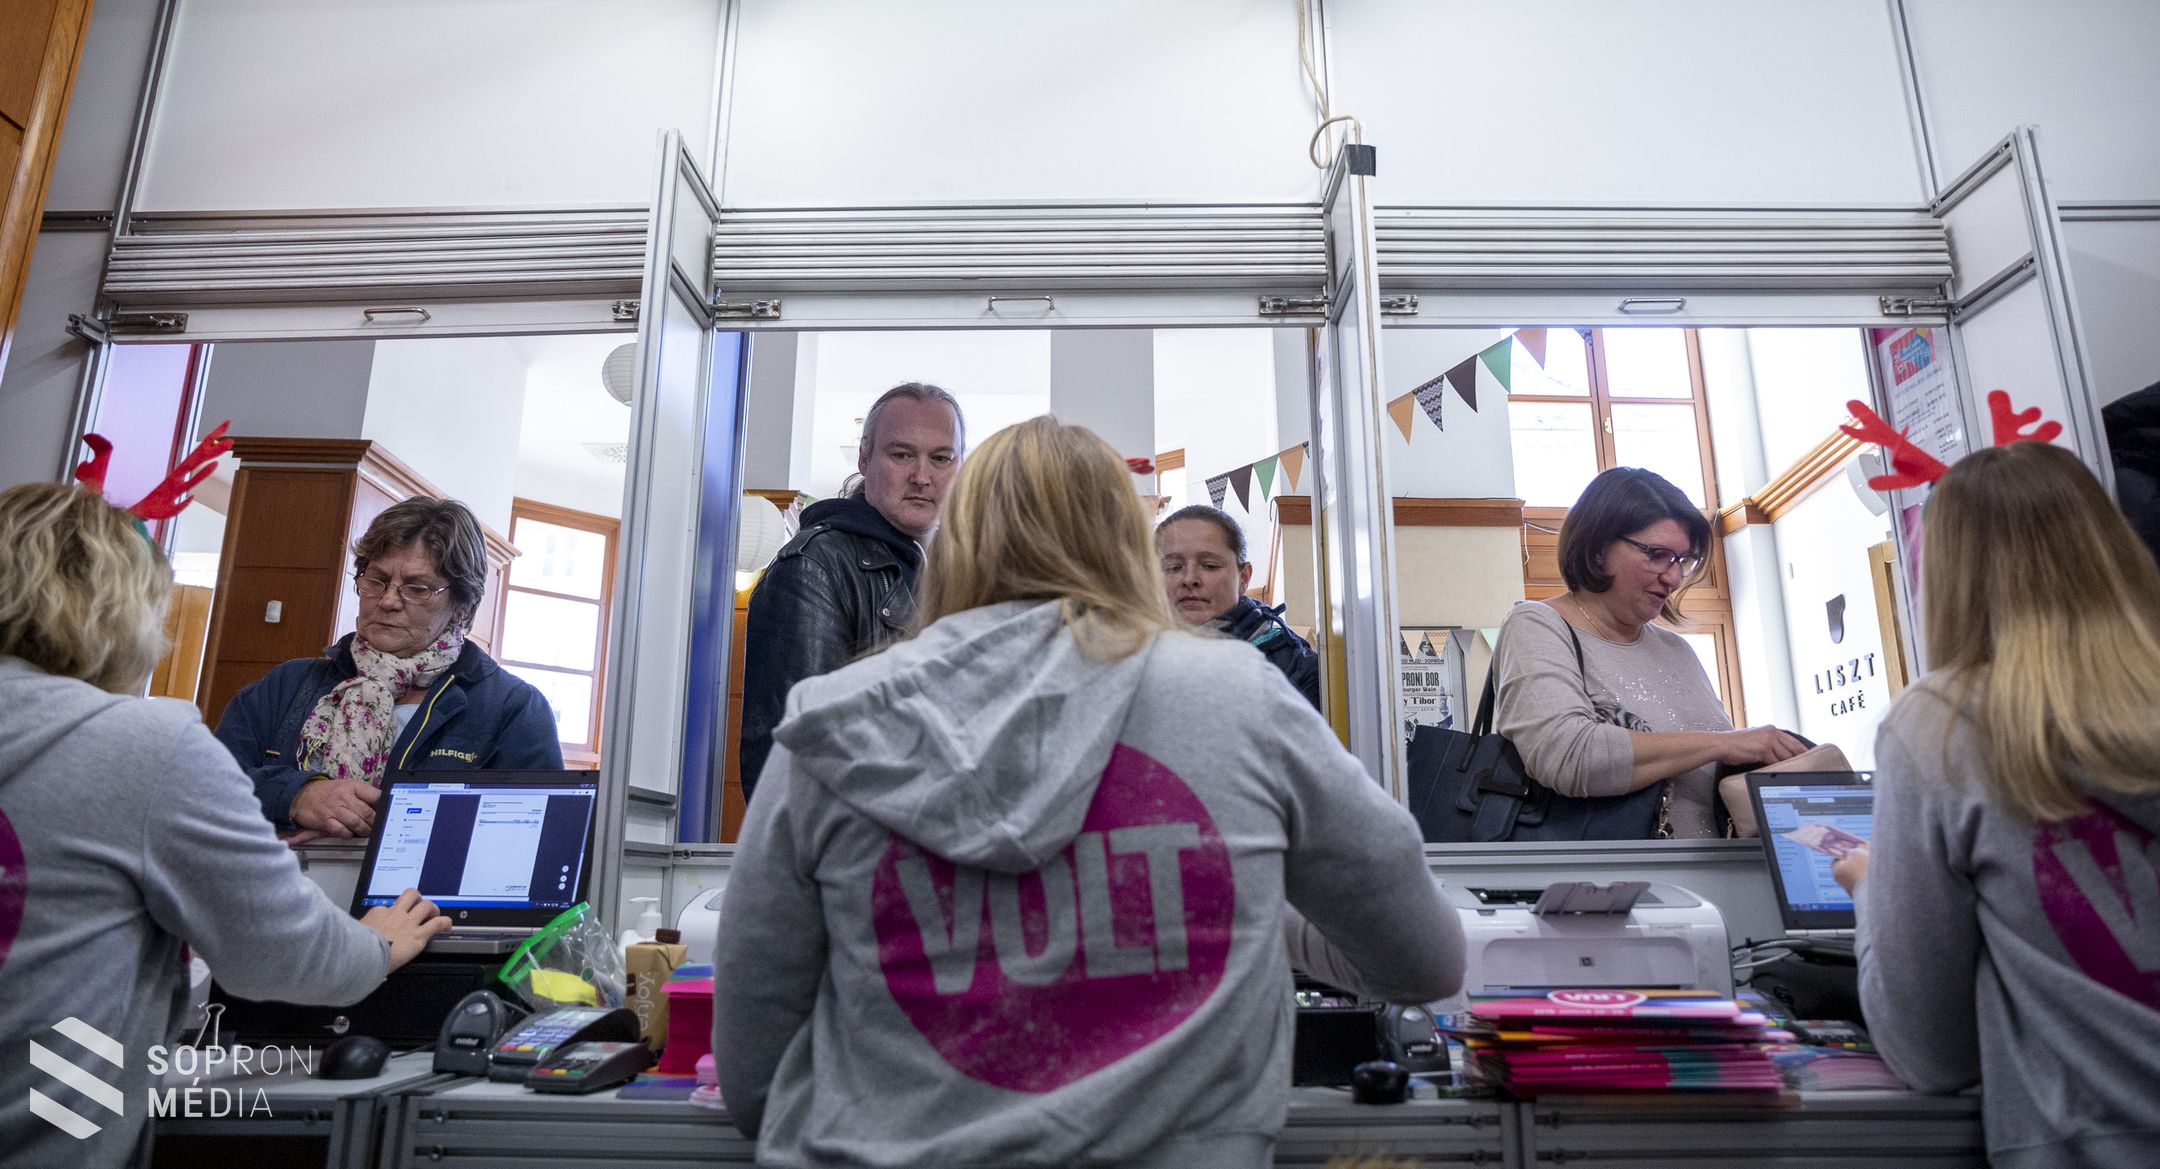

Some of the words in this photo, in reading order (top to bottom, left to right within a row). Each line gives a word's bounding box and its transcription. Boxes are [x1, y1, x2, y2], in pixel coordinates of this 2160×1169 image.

[1425, 672, 1440, 687] BOR
[1814, 652, 1875, 694] LISZT
[1410, 696, 1437, 705] Tibor
[1831, 689, 1866, 716] CAFÉ
[895, 821, 1200, 996] VOLT
